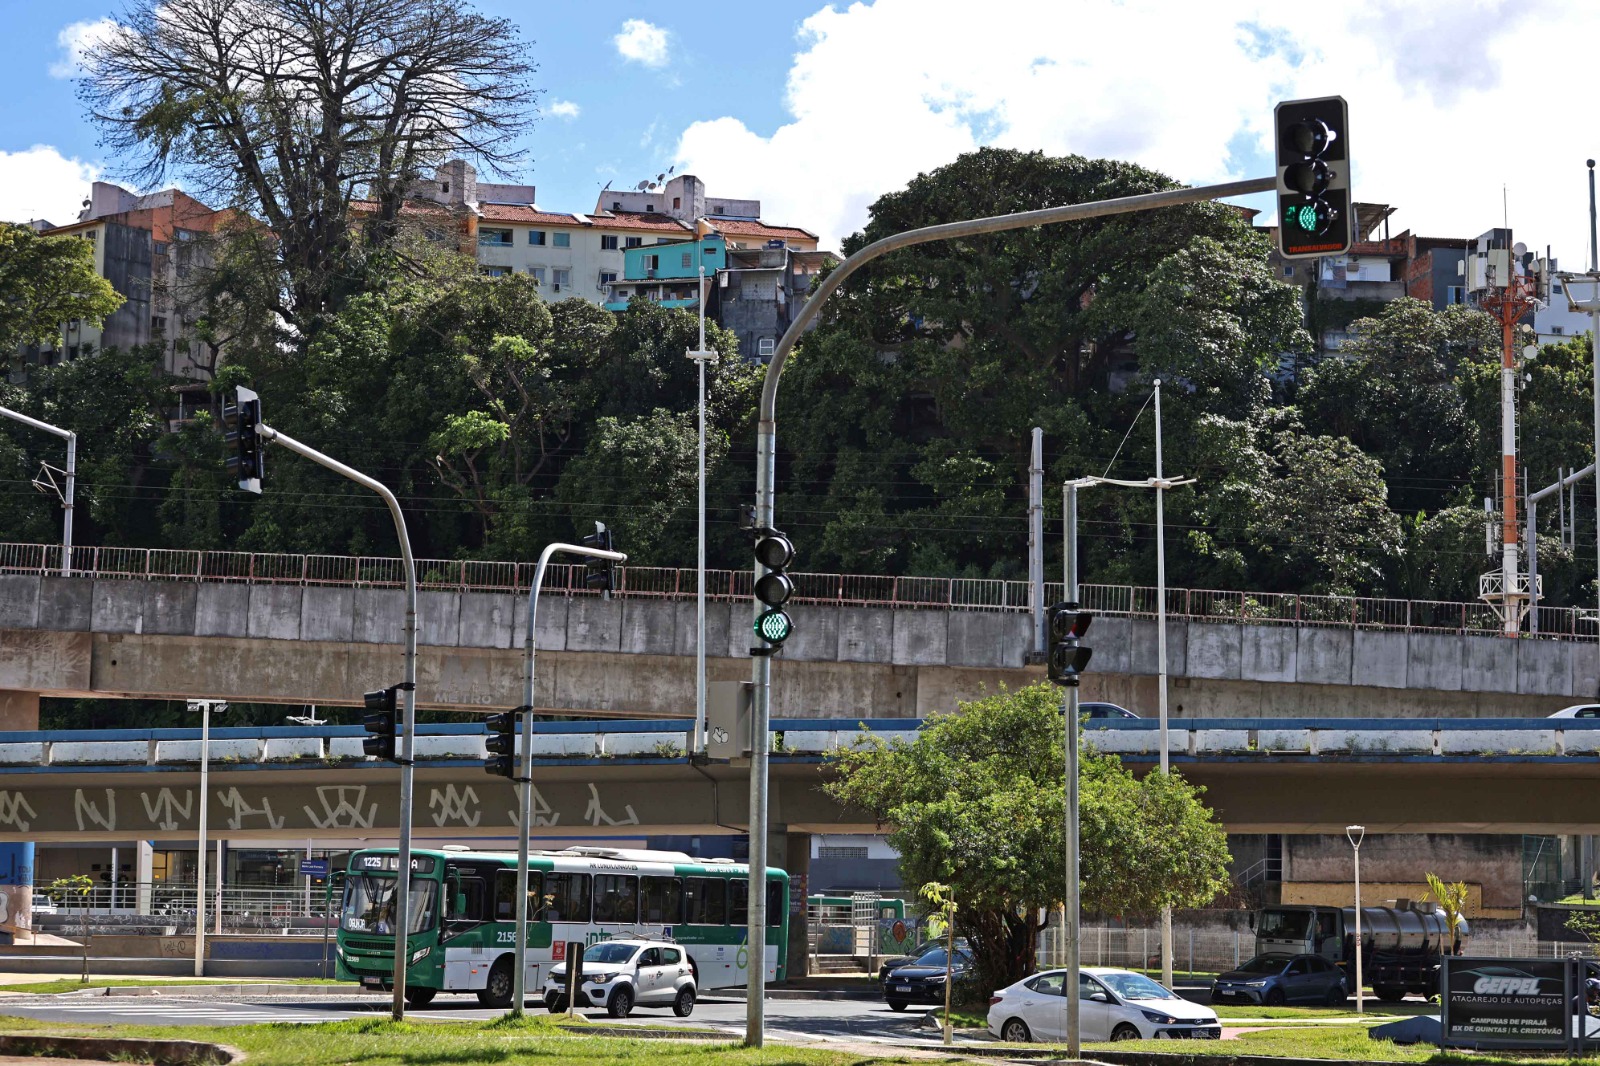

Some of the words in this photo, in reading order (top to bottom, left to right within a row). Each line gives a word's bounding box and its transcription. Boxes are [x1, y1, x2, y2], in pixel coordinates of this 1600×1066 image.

[1288, 243, 1342, 254] TRANSALVADOR
[364, 856, 382, 866] 1225
[390, 858, 418, 869] LA
[496, 931, 516, 942] 2156
[1473, 977, 1541, 995] GEFPEL
[1514, 997, 1563, 1005] AUTOPEÇAS
[1520, 1026, 1562, 1035] CRISTÓVÃO
